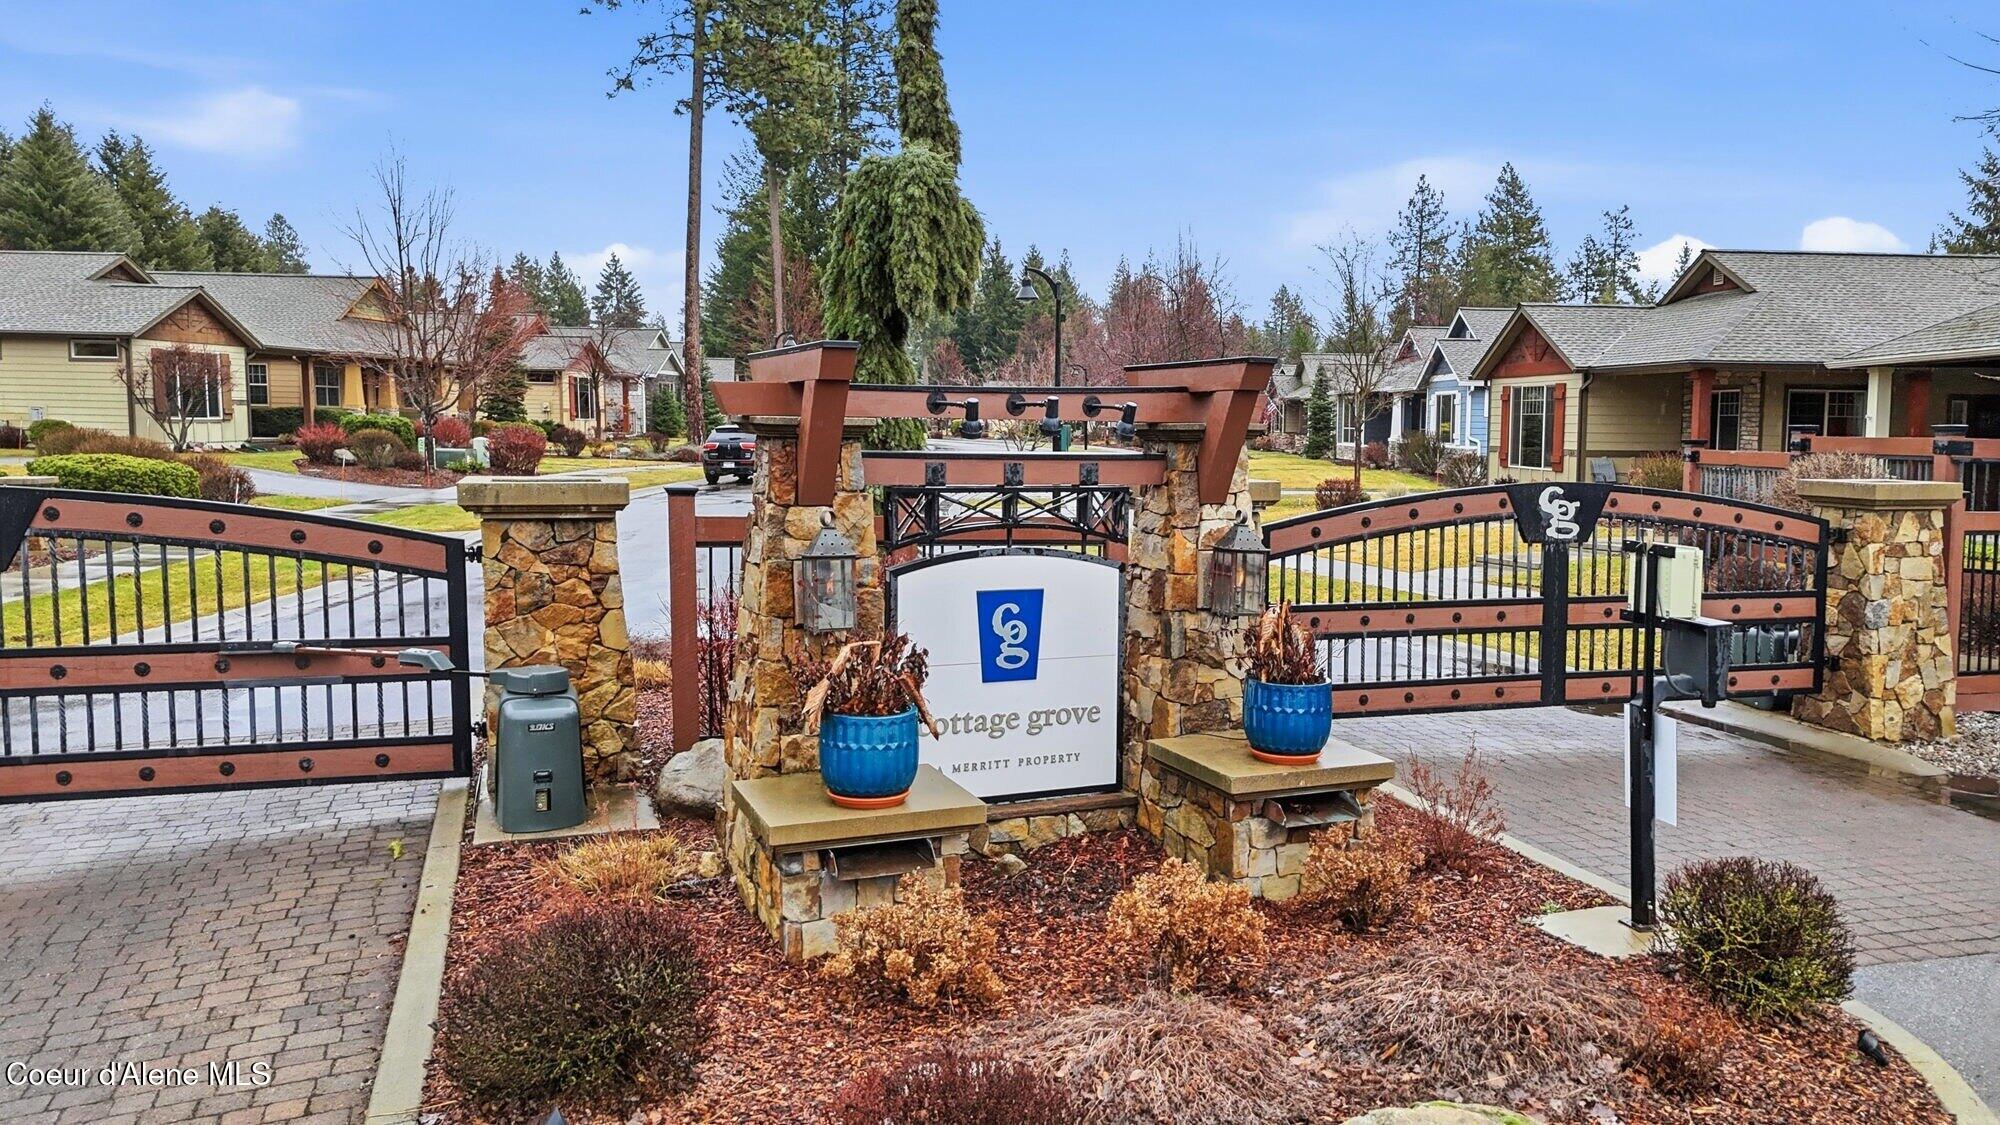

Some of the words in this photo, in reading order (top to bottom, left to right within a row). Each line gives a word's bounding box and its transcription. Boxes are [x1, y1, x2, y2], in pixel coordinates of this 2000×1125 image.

[1026, 705, 1101, 736] grove
[952, 759, 1010, 774] MERRITT
[1018, 752, 1081, 767] PROPERTY
